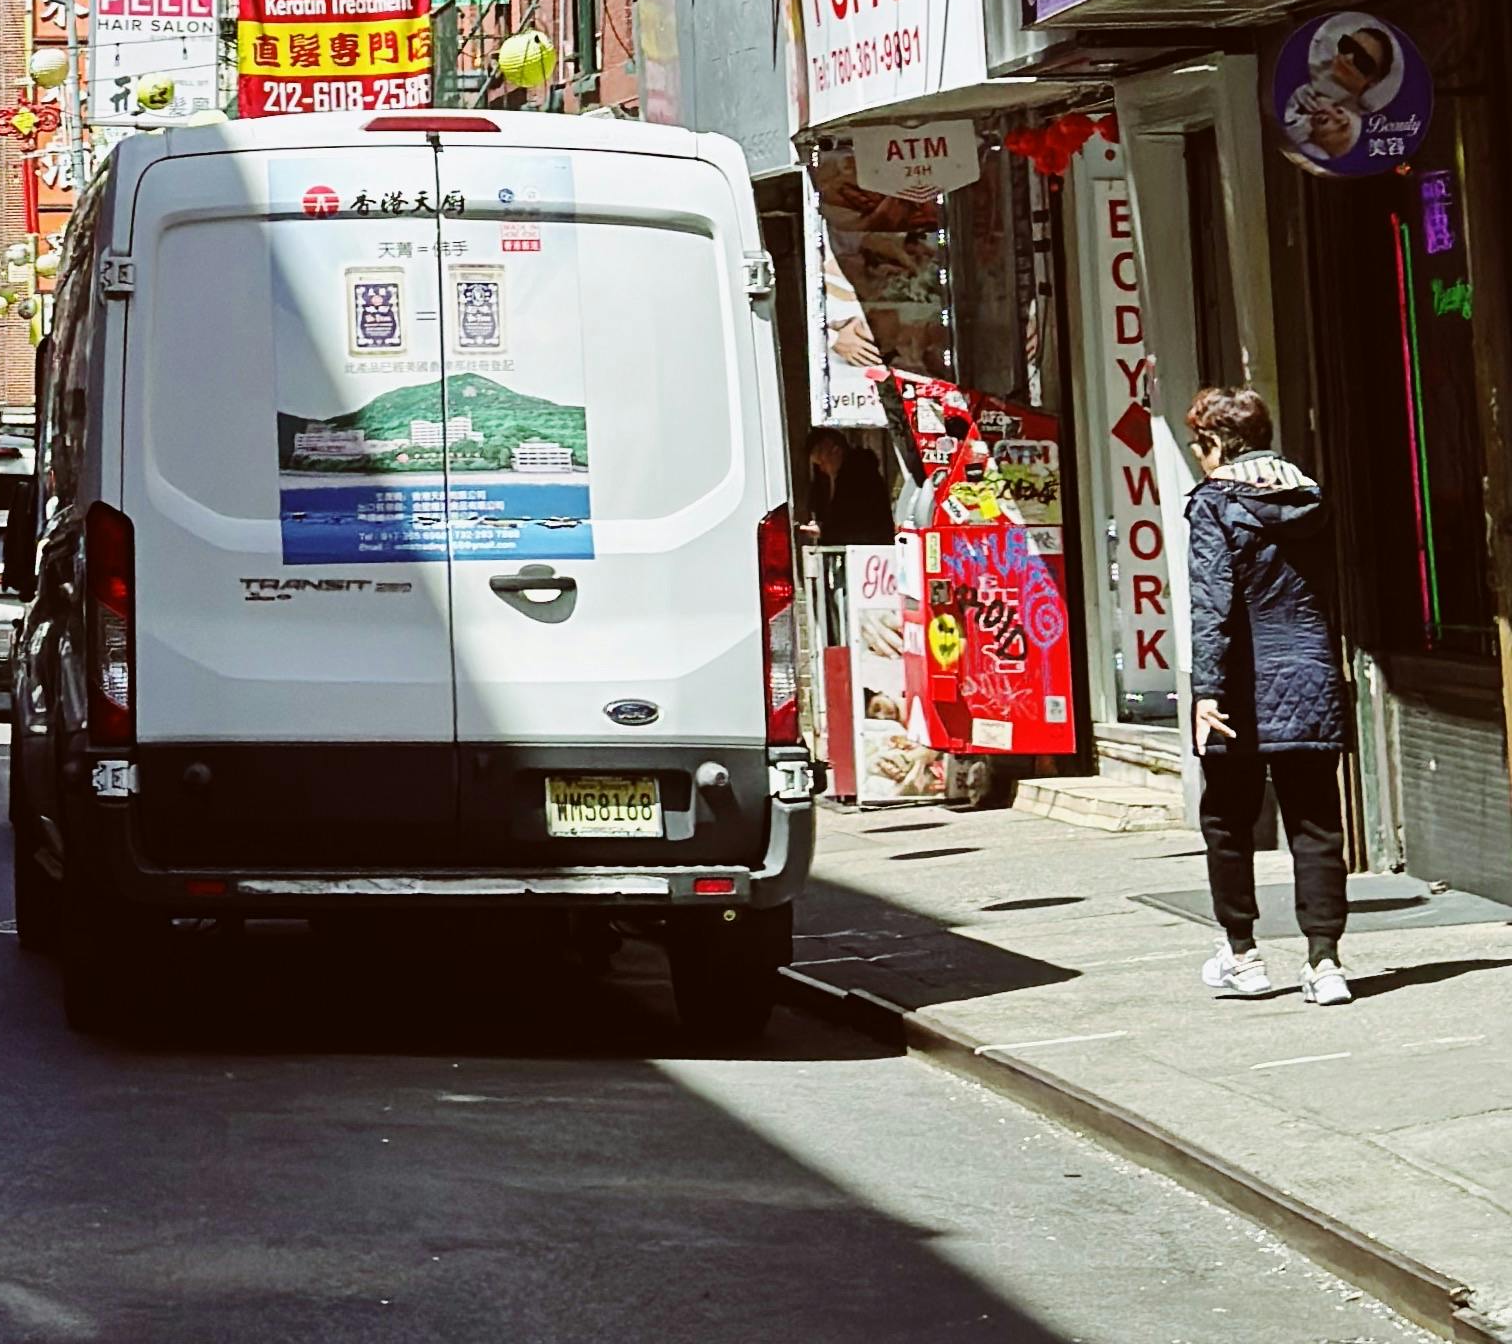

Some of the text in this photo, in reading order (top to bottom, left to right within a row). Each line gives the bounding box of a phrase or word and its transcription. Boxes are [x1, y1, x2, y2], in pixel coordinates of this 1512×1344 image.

[97, 18, 215, 34] HAIR SALON
[886, 136, 948, 162] ATM
[239, 577, 373, 592] TRANSIT
